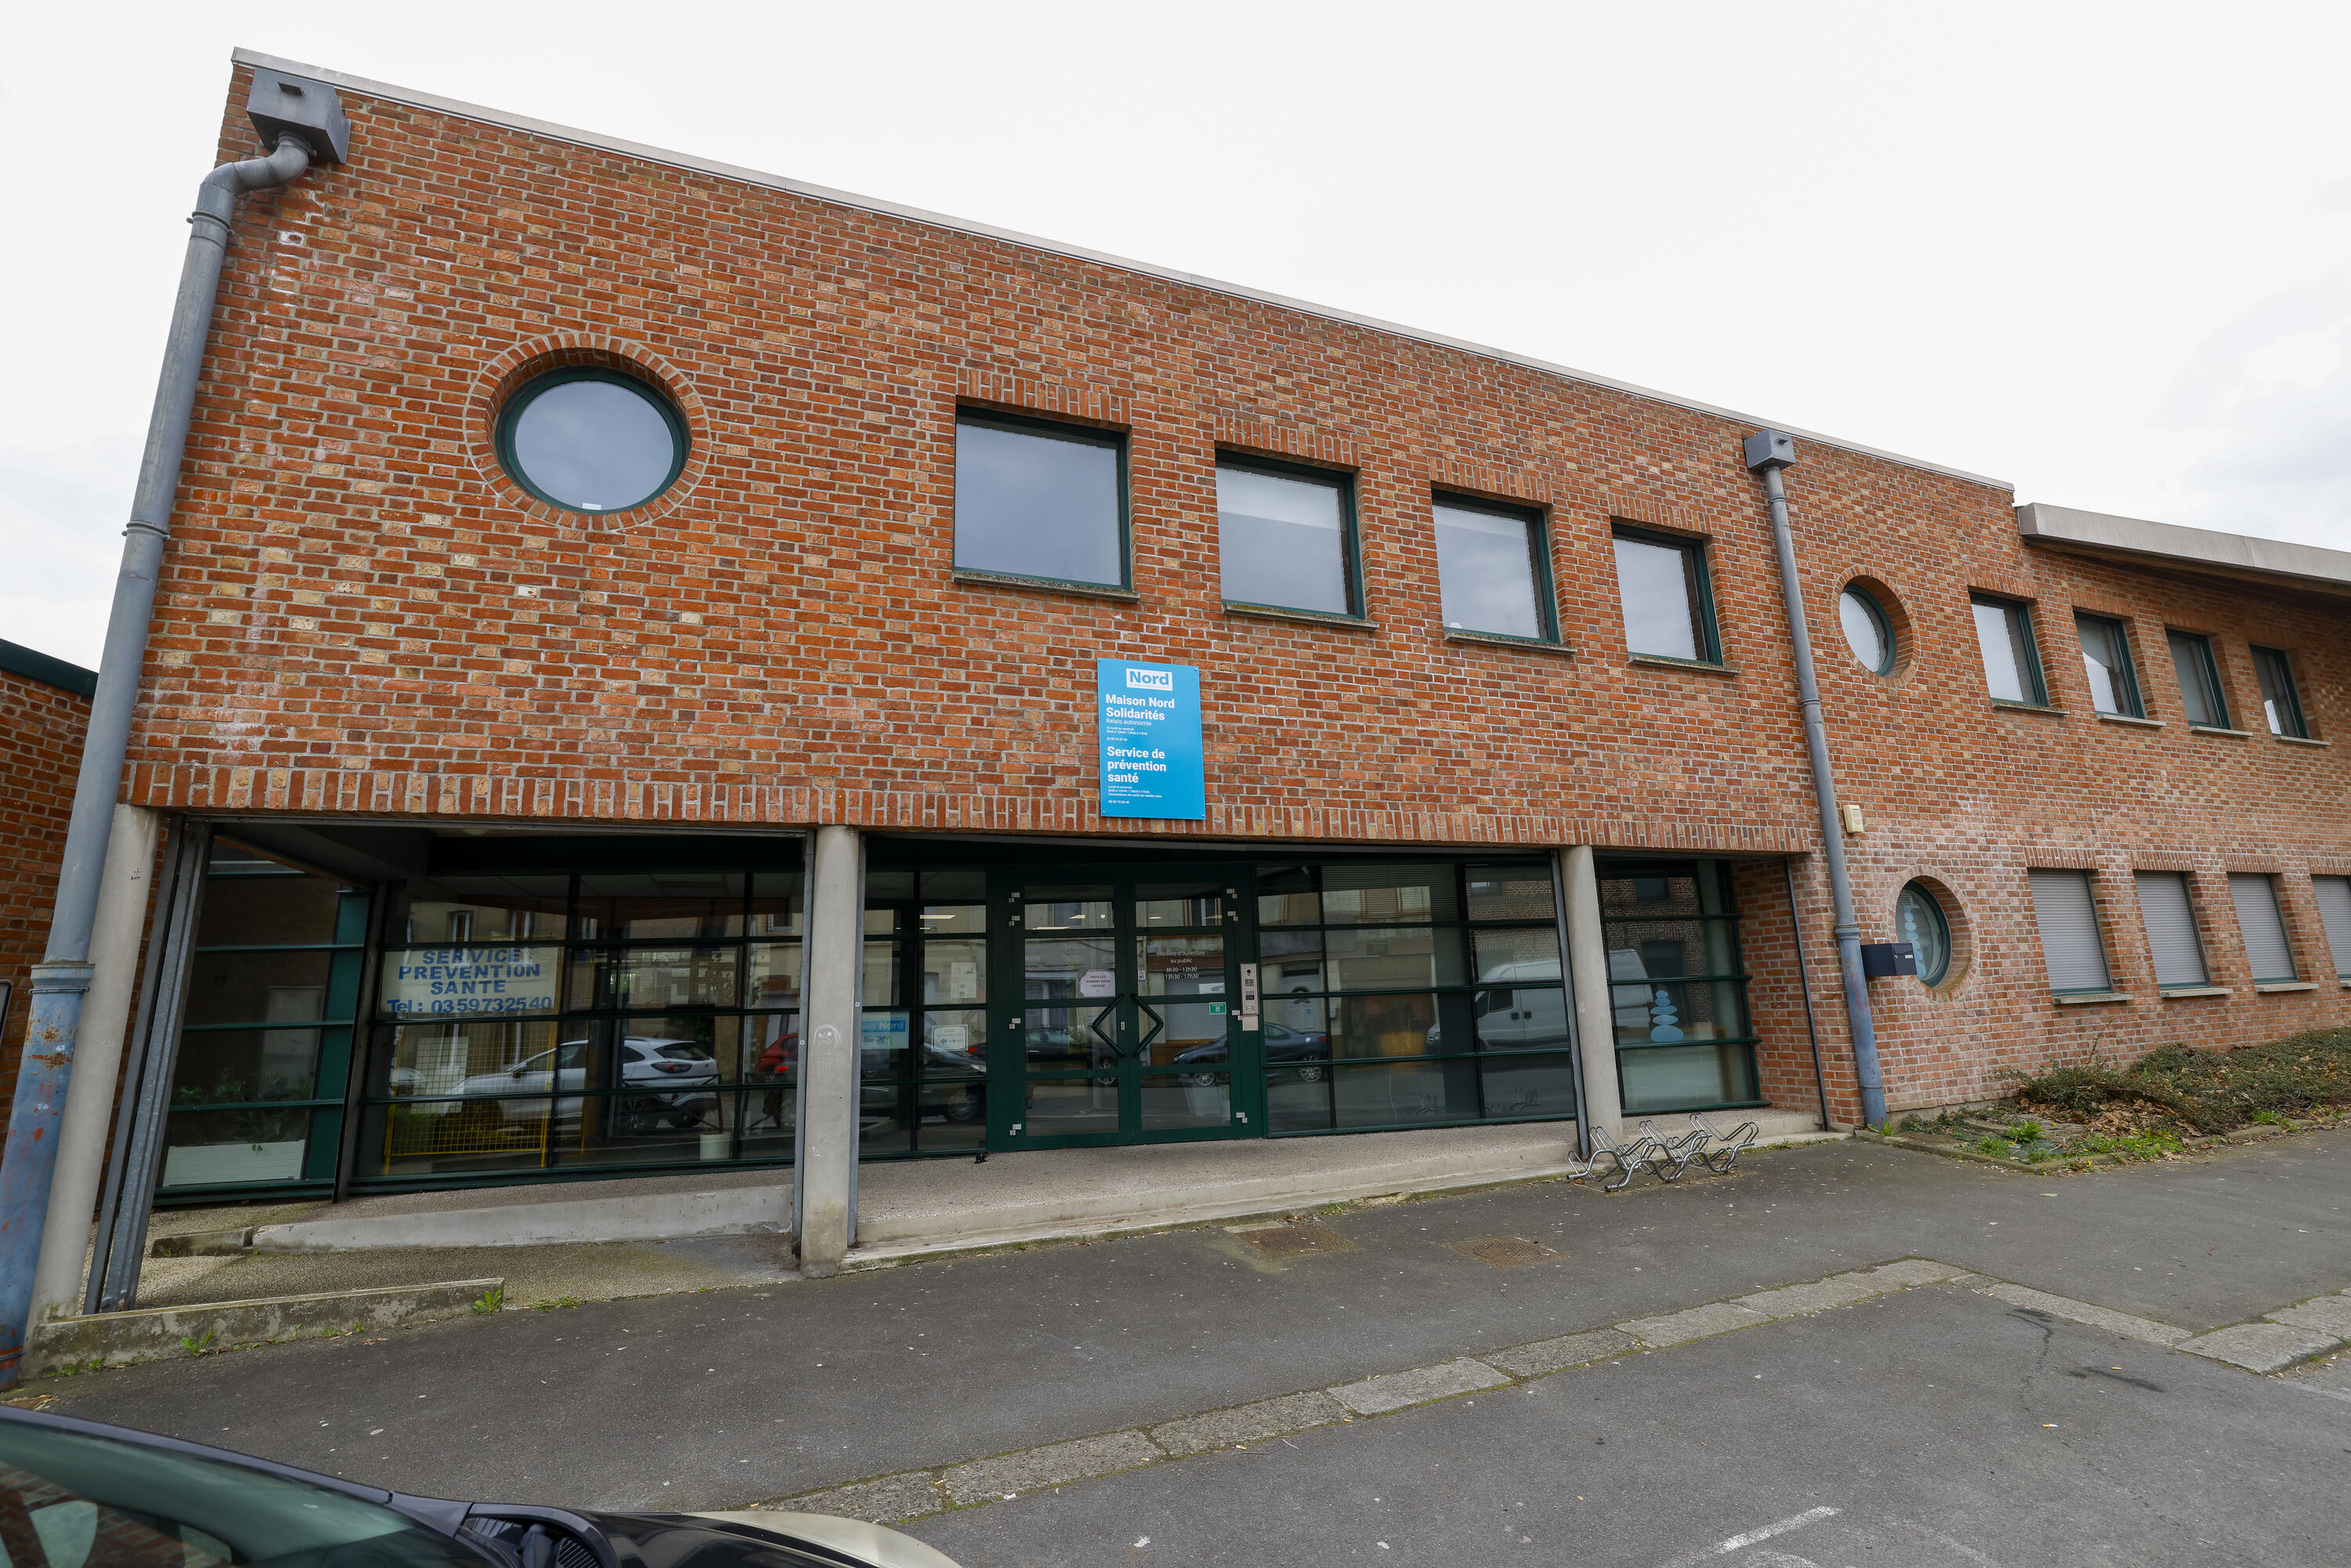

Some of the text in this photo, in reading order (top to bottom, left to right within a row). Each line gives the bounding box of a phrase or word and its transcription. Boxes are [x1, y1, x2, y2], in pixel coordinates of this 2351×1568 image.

[1129, 671, 1169, 686] Nord
[1106, 693, 1175, 708] Maison Nord
[1106, 707, 1165, 720] Solidarités
[1107, 746, 1165, 759] Service de
[1107, 759, 1167, 772] prévention
[1107, 772, 1139, 783] santé
[422, 949, 521, 965] SERVICE
[398, 963, 540, 980] PREVENTION
[430, 980, 506, 995] SANTE
[386, 999, 412, 1012] Tel
[431, 997, 552, 1013] 0359732540
